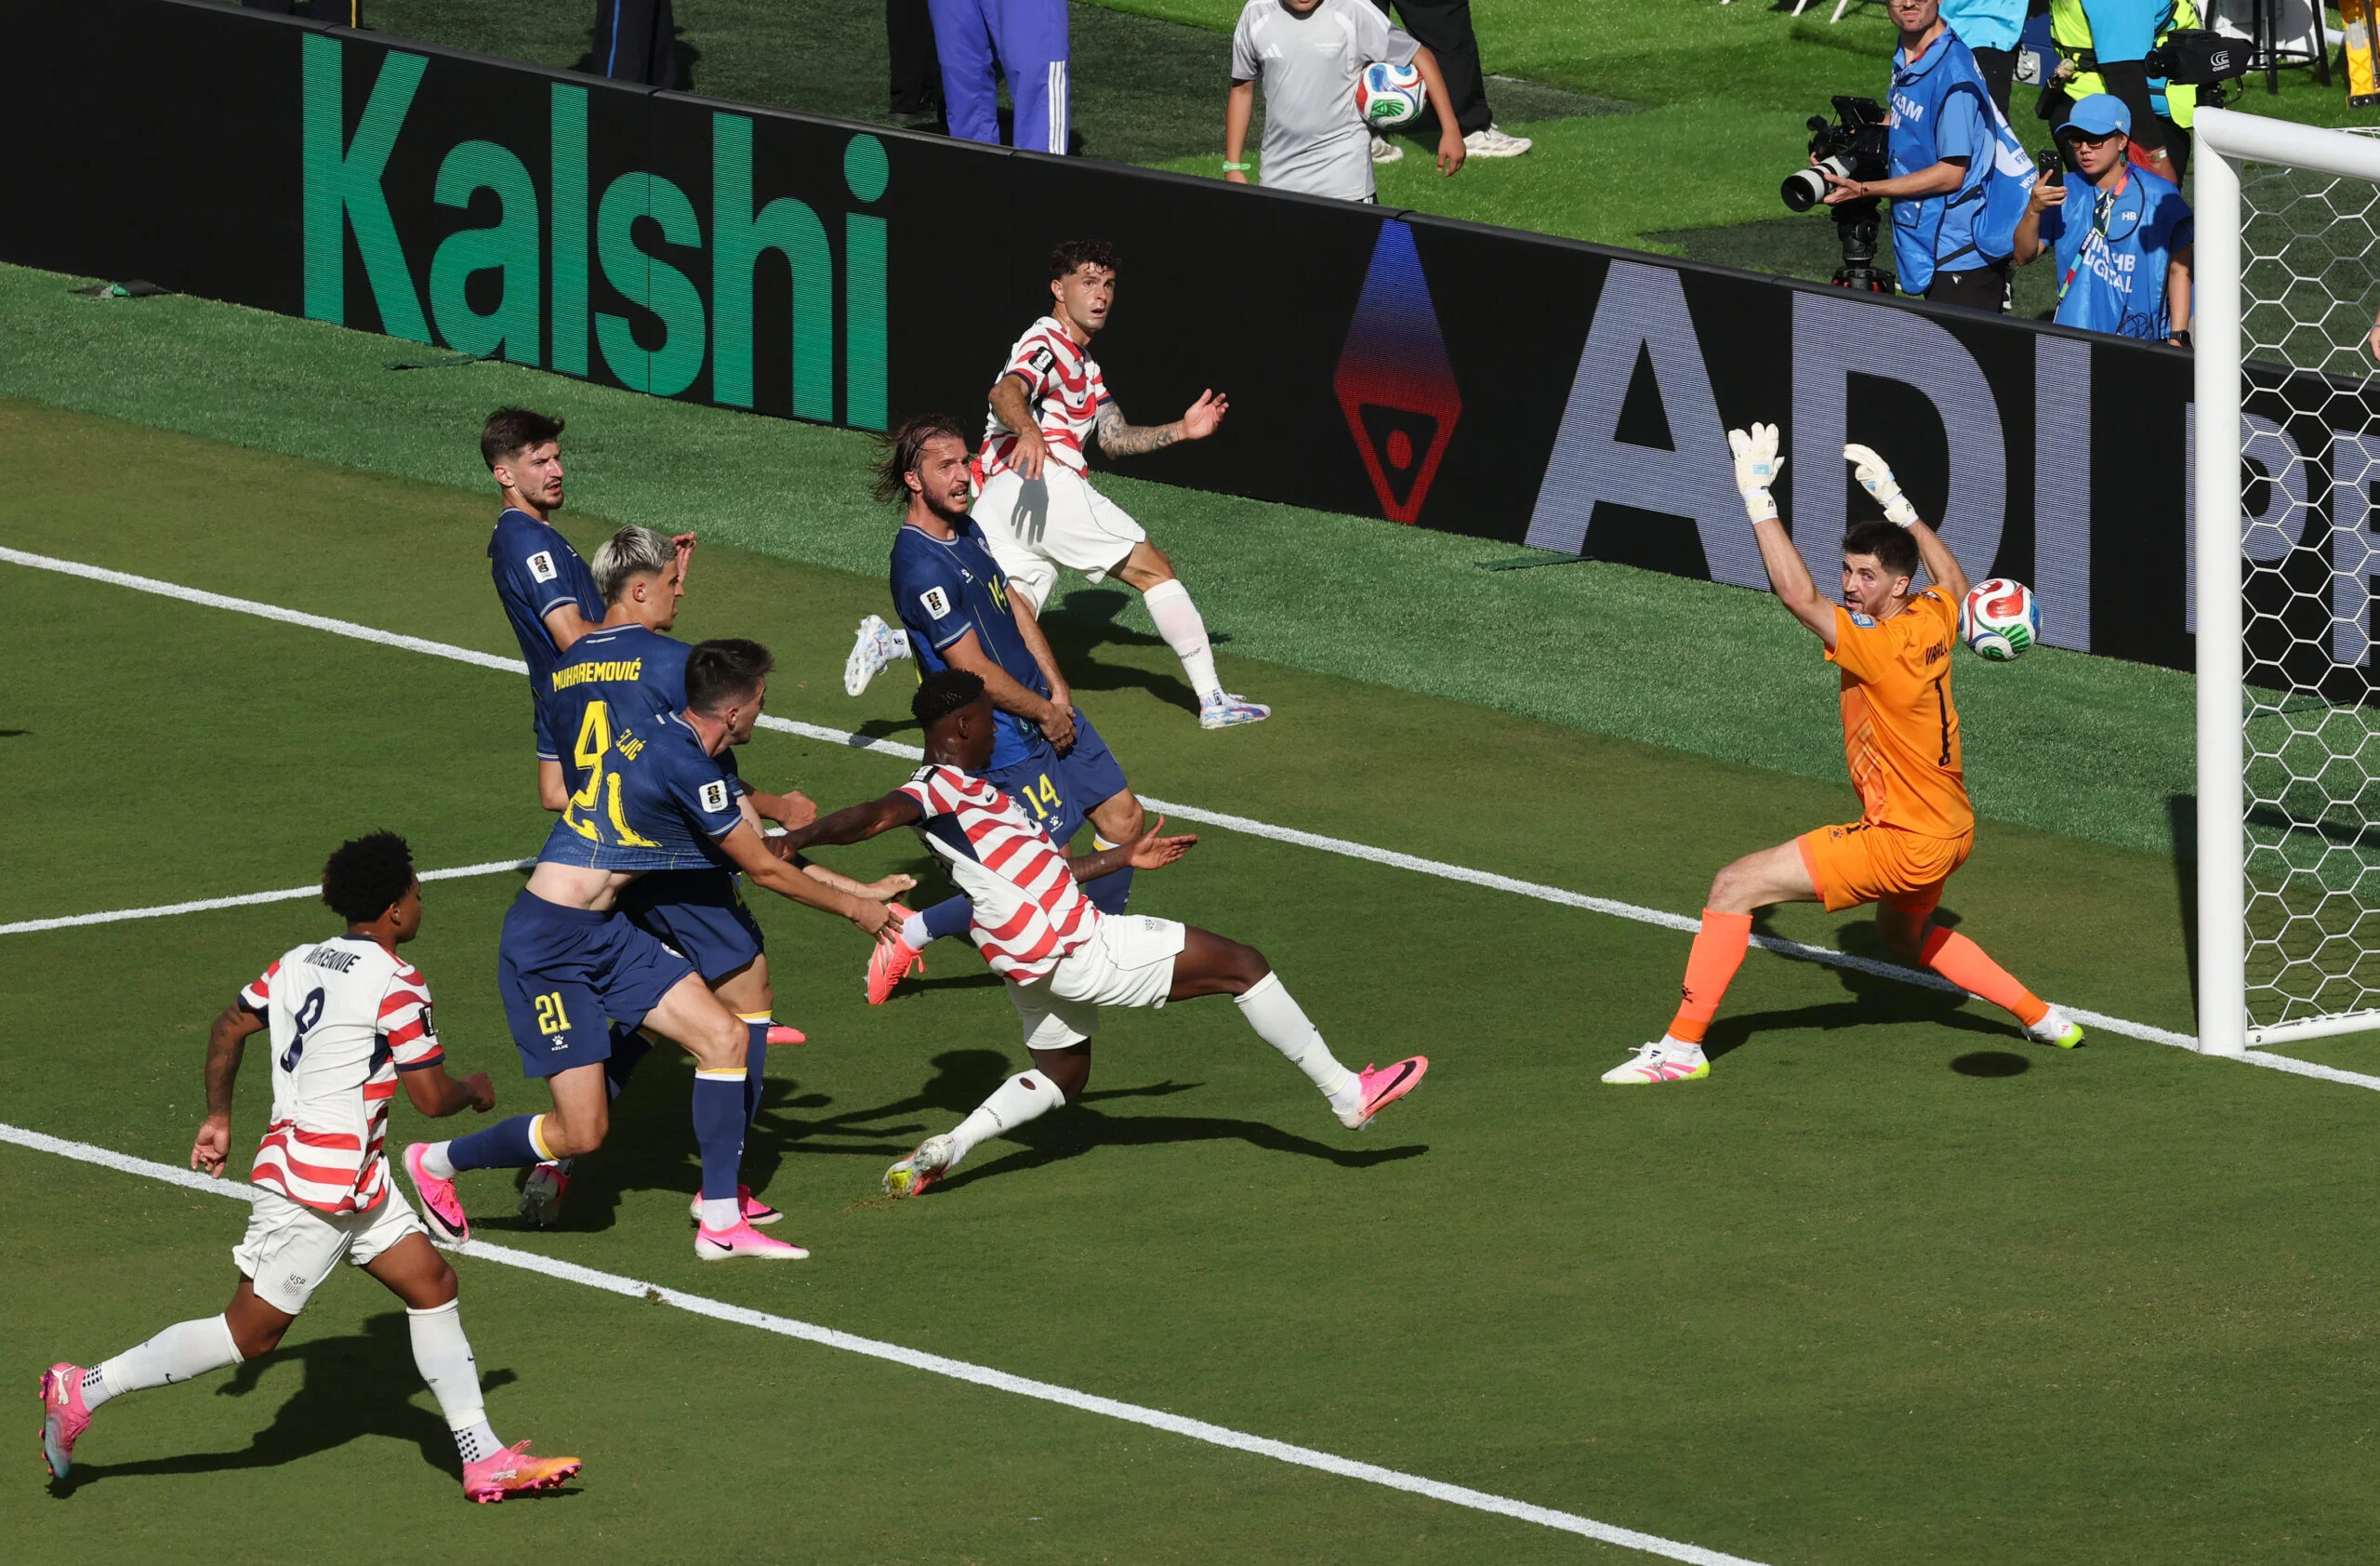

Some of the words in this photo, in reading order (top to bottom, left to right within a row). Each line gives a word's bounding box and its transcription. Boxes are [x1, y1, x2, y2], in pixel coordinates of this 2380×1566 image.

[302, 32, 889, 432] Kalshi
[2122, 211, 2136, 221] HB
[1524, 259, 2092, 654] ADI
[552, 657, 641, 692] MUHAREMOVIĆ
[574, 700, 612, 770] 4
[562, 757, 663, 847] 21
[1022, 773, 1063, 820] 14
[303, 946, 362, 975] McKENNIE
[535, 991, 572, 1036] 21
[289, 1273, 306, 1285] USA
